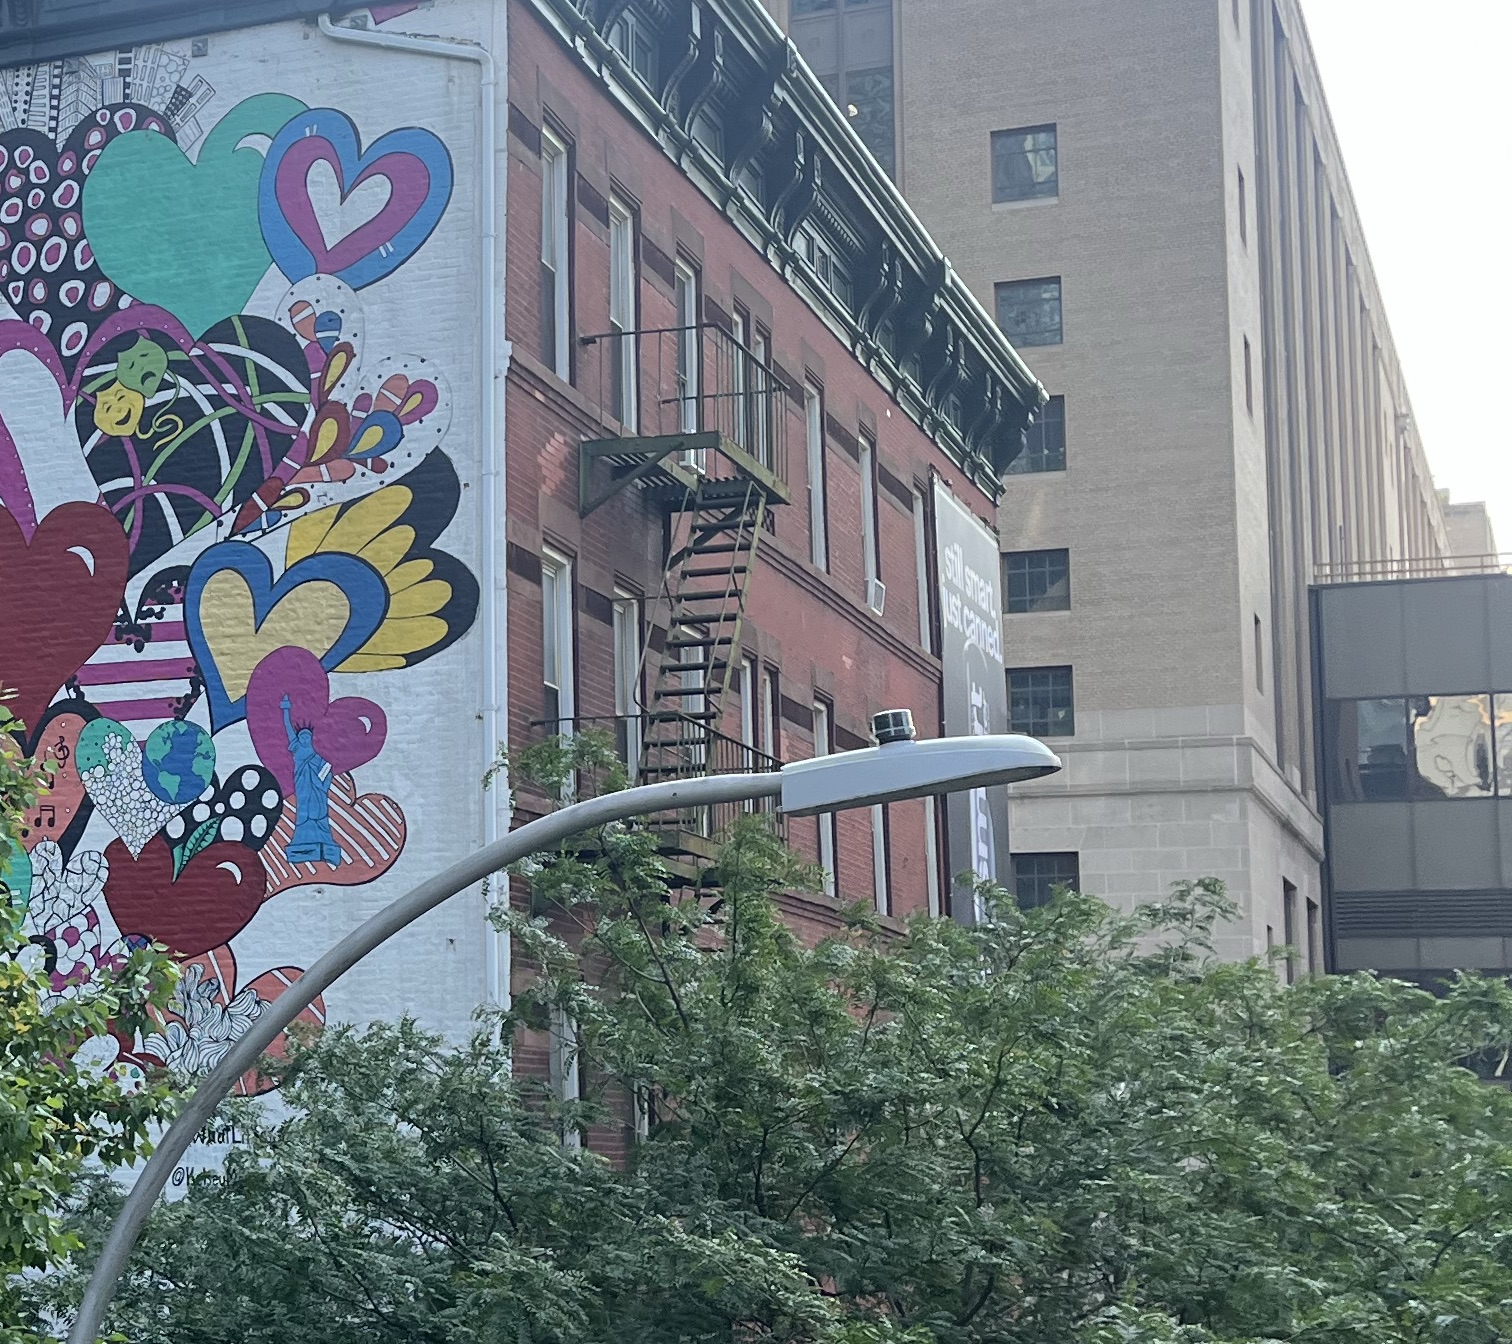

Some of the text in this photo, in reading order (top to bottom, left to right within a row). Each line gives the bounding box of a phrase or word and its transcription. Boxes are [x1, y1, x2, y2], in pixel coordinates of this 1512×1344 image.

[941, 573, 1003, 664] just canned.
[944, 542, 996, 620] still smart.
